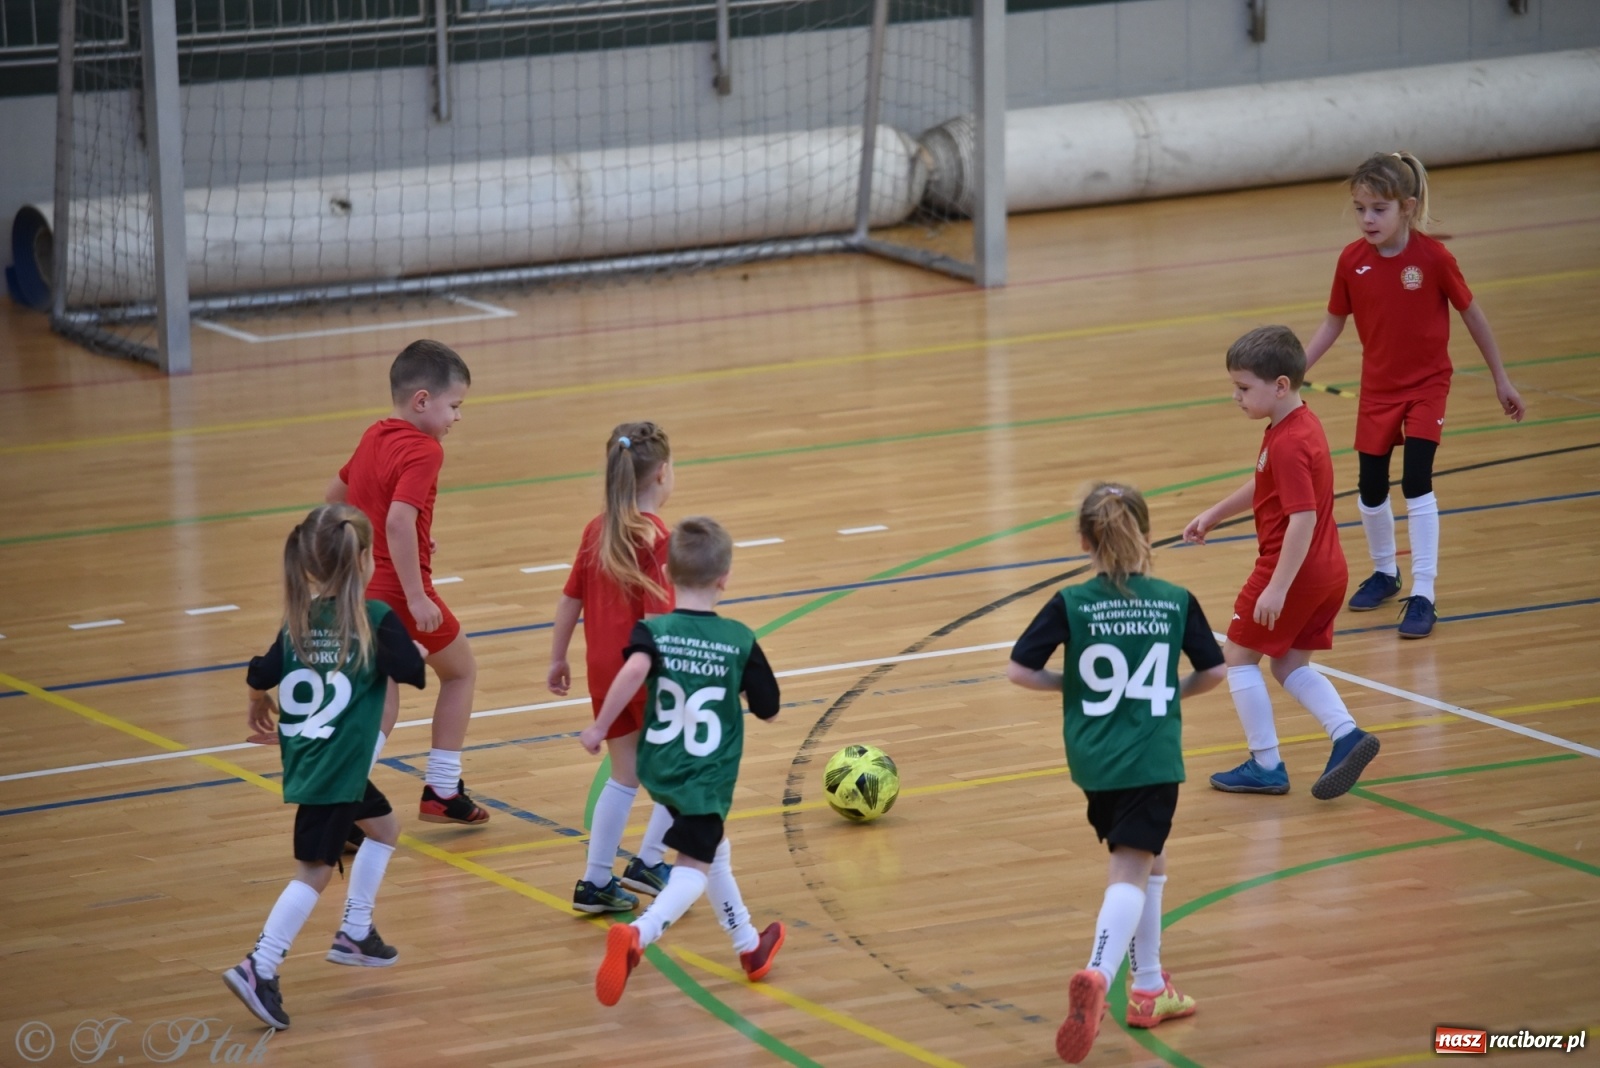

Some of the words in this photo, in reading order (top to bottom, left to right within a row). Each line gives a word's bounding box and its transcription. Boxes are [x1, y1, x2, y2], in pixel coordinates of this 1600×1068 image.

[1088, 617, 1172, 636] TWORKÓW
[278, 668, 352, 740] 92
[1078, 641, 1176, 717] 94
[645, 676, 726, 757] 96
